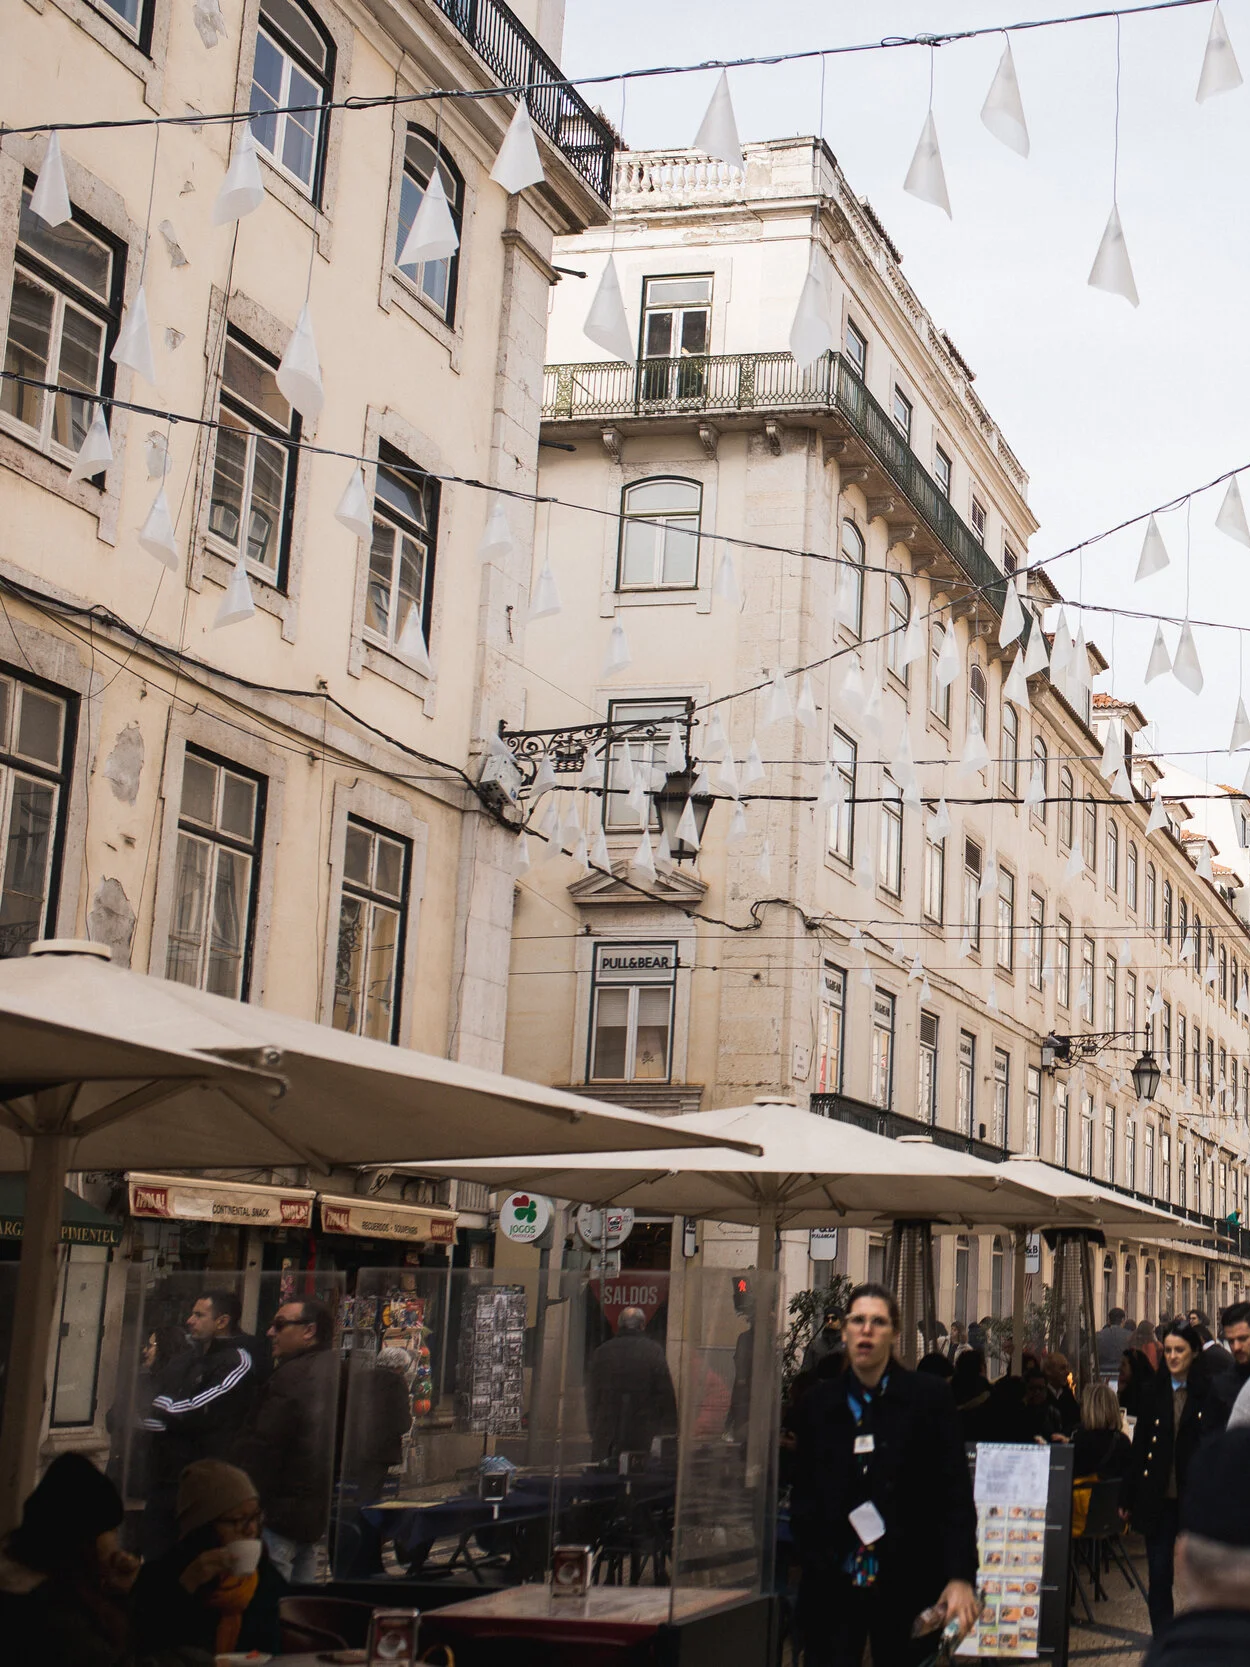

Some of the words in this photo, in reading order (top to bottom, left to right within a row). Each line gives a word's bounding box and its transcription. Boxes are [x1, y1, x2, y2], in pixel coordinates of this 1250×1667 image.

[602, 957, 669, 969] PULL&BEAR
[212, 1204, 251, 1217] CONTINENTAL
[251, 1207, 270, 1218] SNACK
[509, 1225, 536, 1236] JOGOS
[604, 1284, 659, 1306] SALDOS
